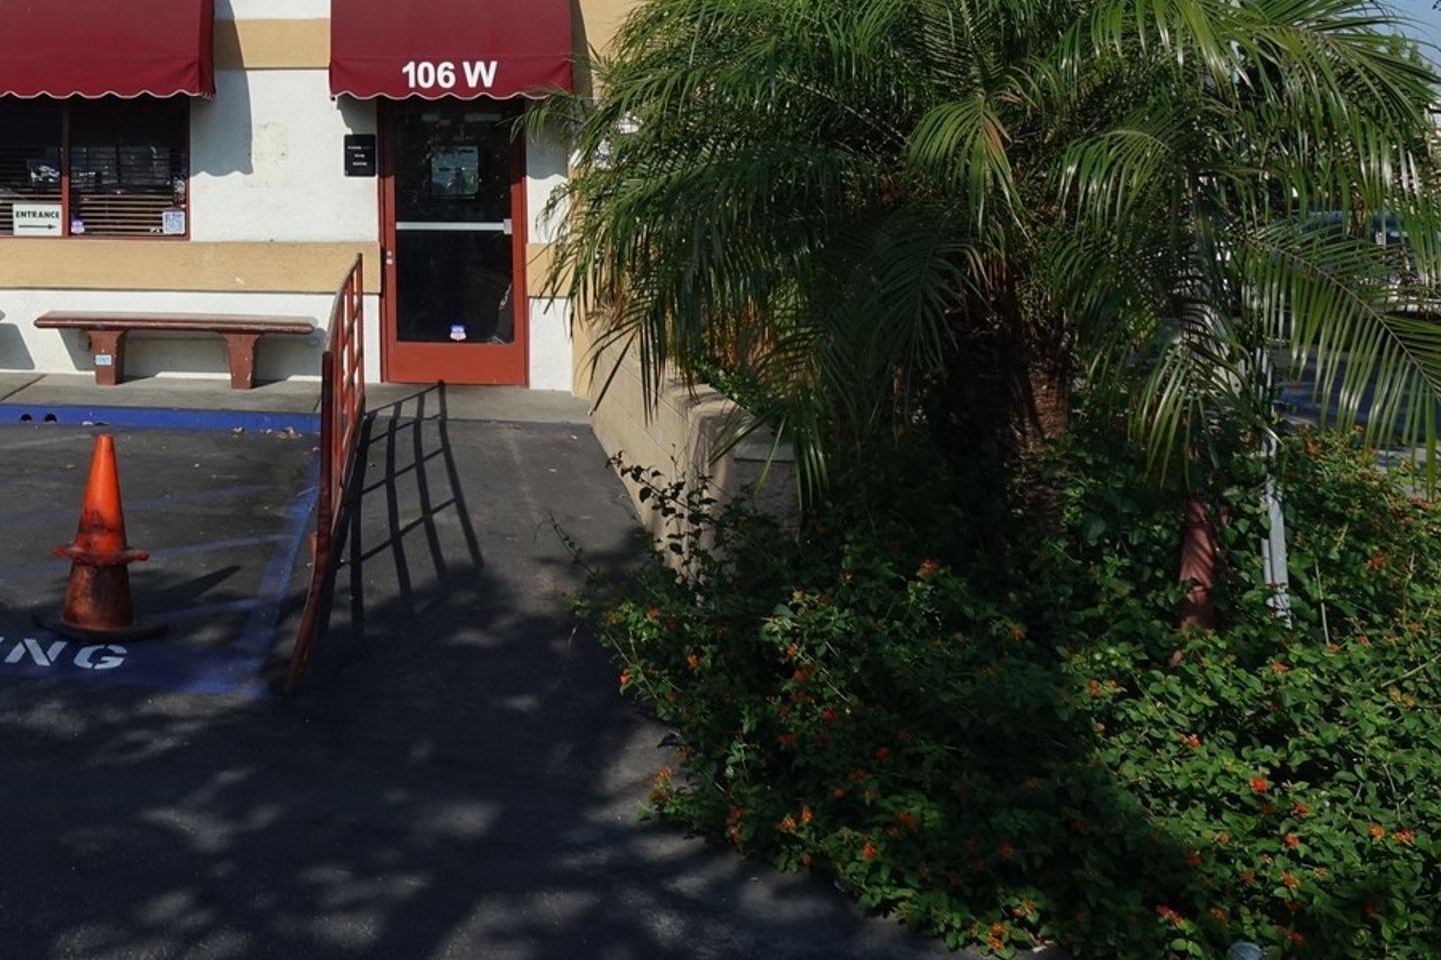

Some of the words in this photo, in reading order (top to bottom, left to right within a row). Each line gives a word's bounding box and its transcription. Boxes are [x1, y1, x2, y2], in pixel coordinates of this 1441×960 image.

[402, 61, 456, 88] 106
[463, 61, 497, 87] W
[15, 210, 60, 219] ENTRANCE
